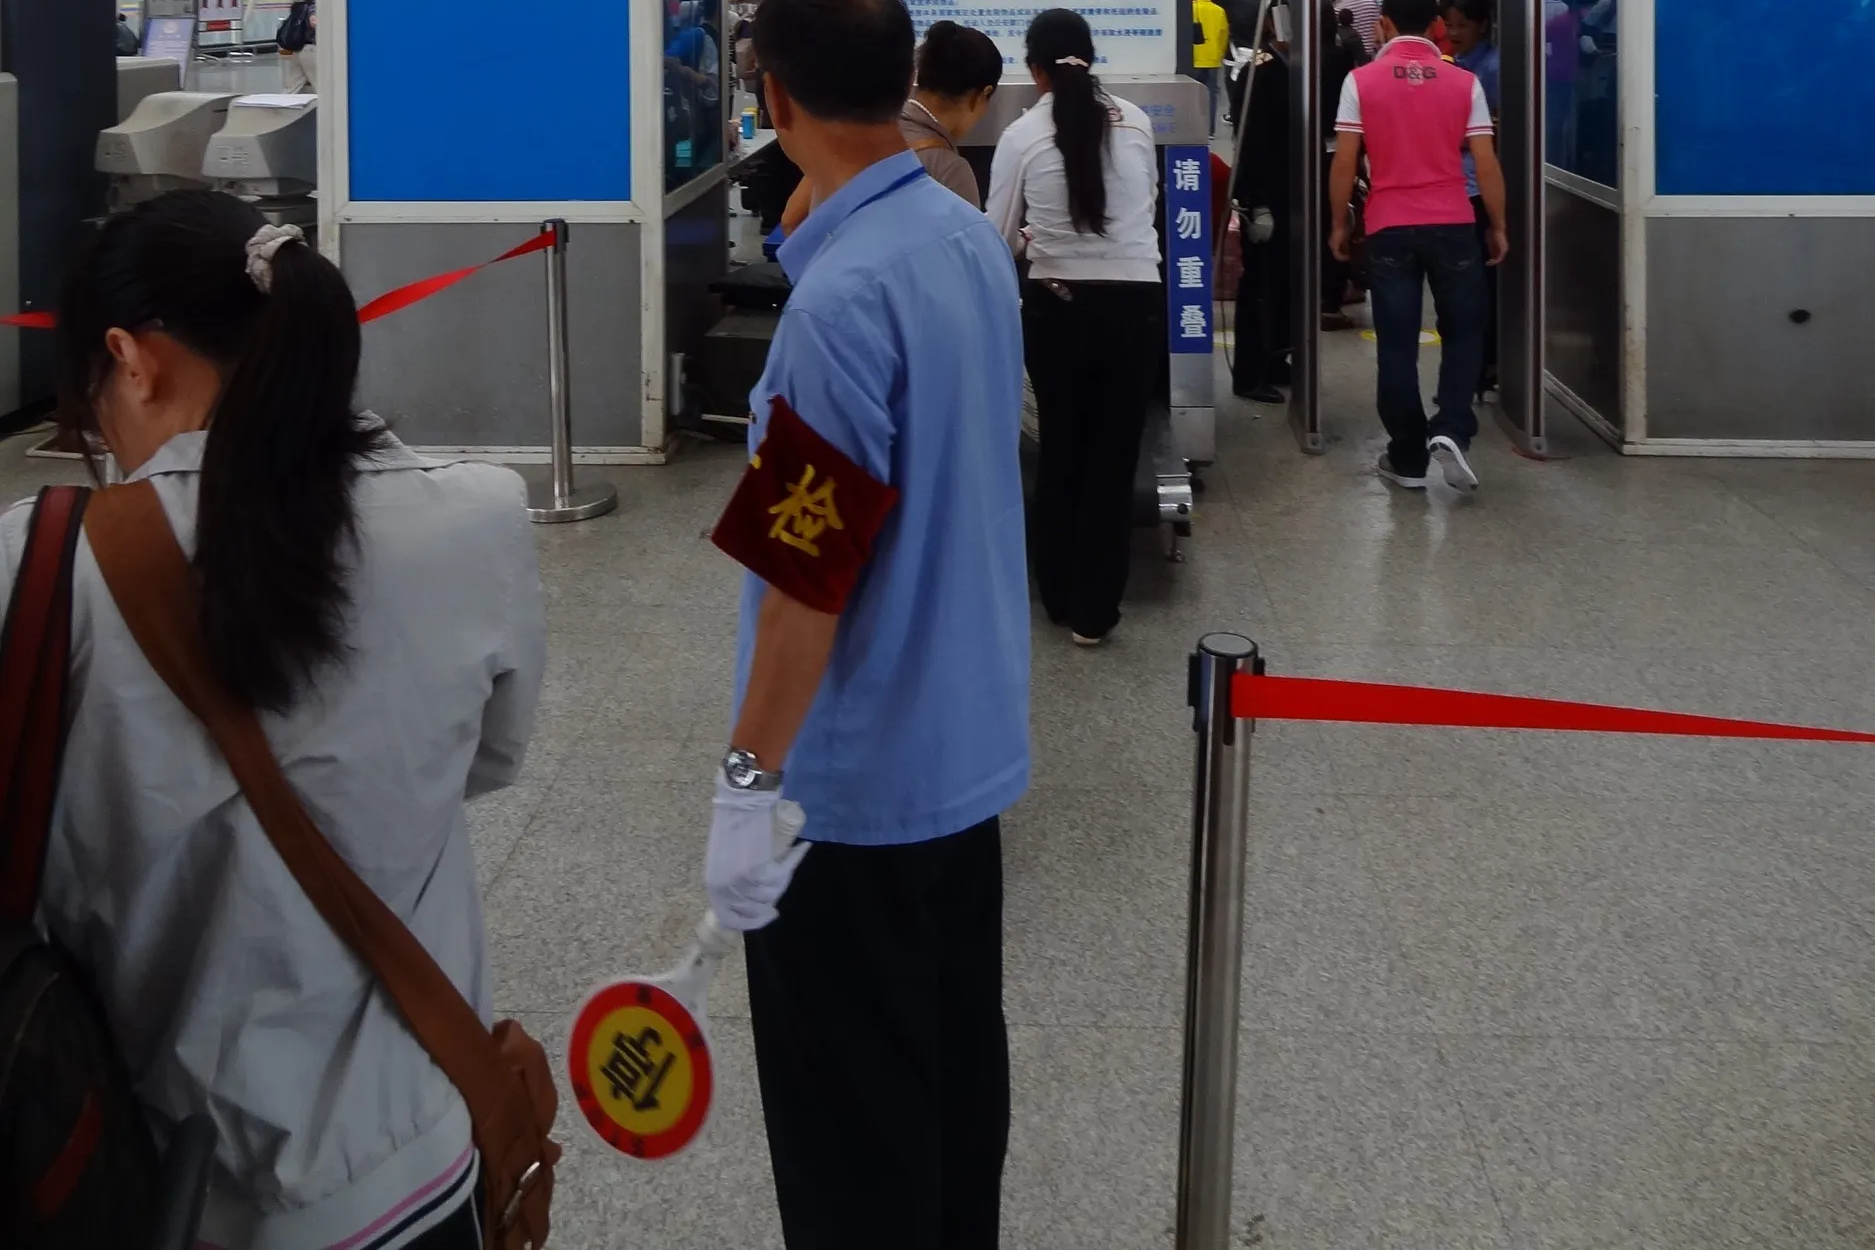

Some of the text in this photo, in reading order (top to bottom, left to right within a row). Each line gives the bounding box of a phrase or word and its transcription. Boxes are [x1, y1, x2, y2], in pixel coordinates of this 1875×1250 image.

[1393, 66, 1437, 79] D&G
[1173, 158, 1207, 338] 请勿重叠
[768, 464, 845, 557] 检
[600, 1026, 676, 1111] 停
